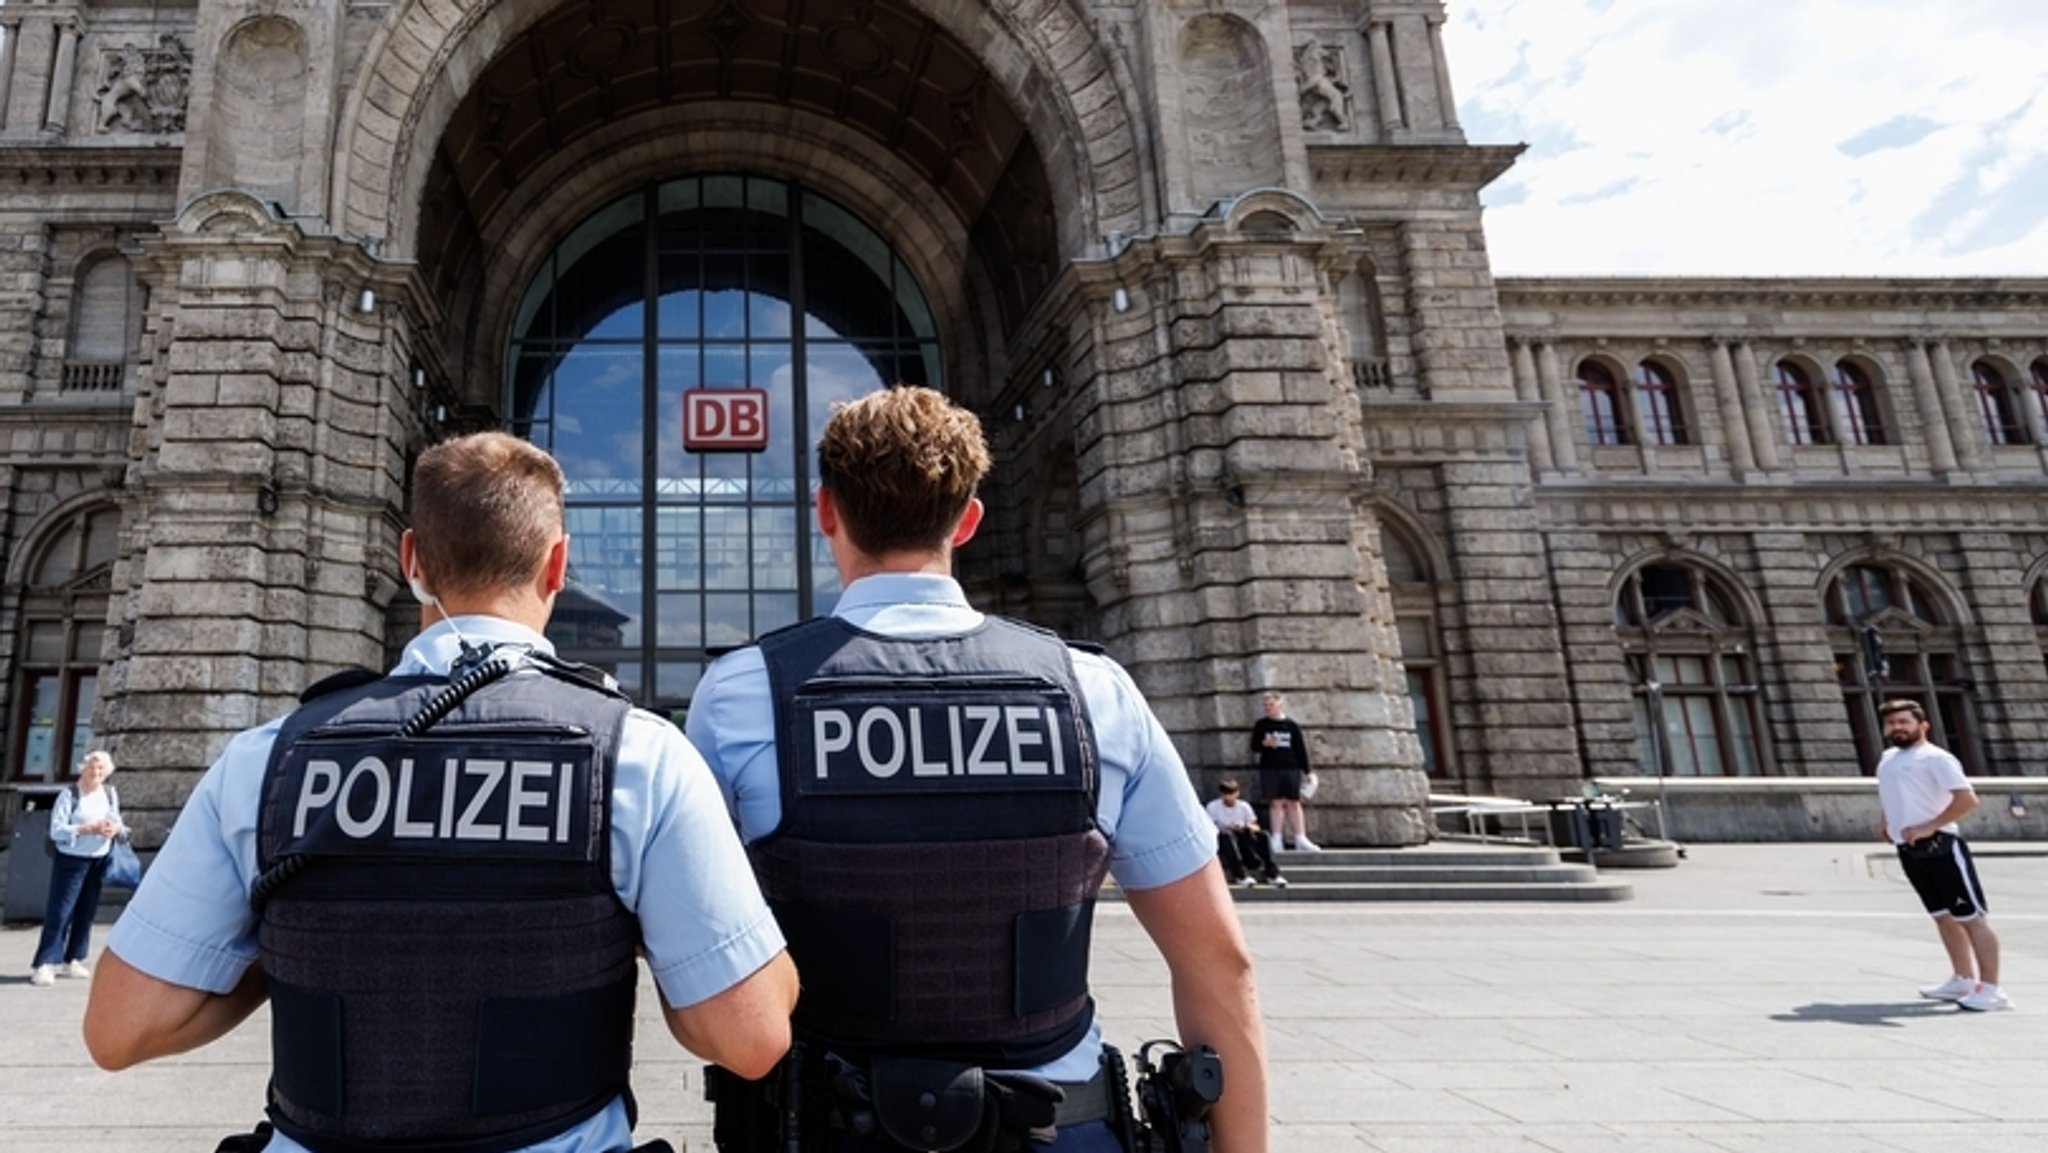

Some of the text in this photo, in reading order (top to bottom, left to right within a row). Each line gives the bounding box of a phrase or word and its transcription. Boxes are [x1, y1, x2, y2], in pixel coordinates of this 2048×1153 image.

[696, 399, 759, 436] DB
[813, 706, 1066, 778] POLIZEI
[293, 757, 574, 842] POLIZEI
